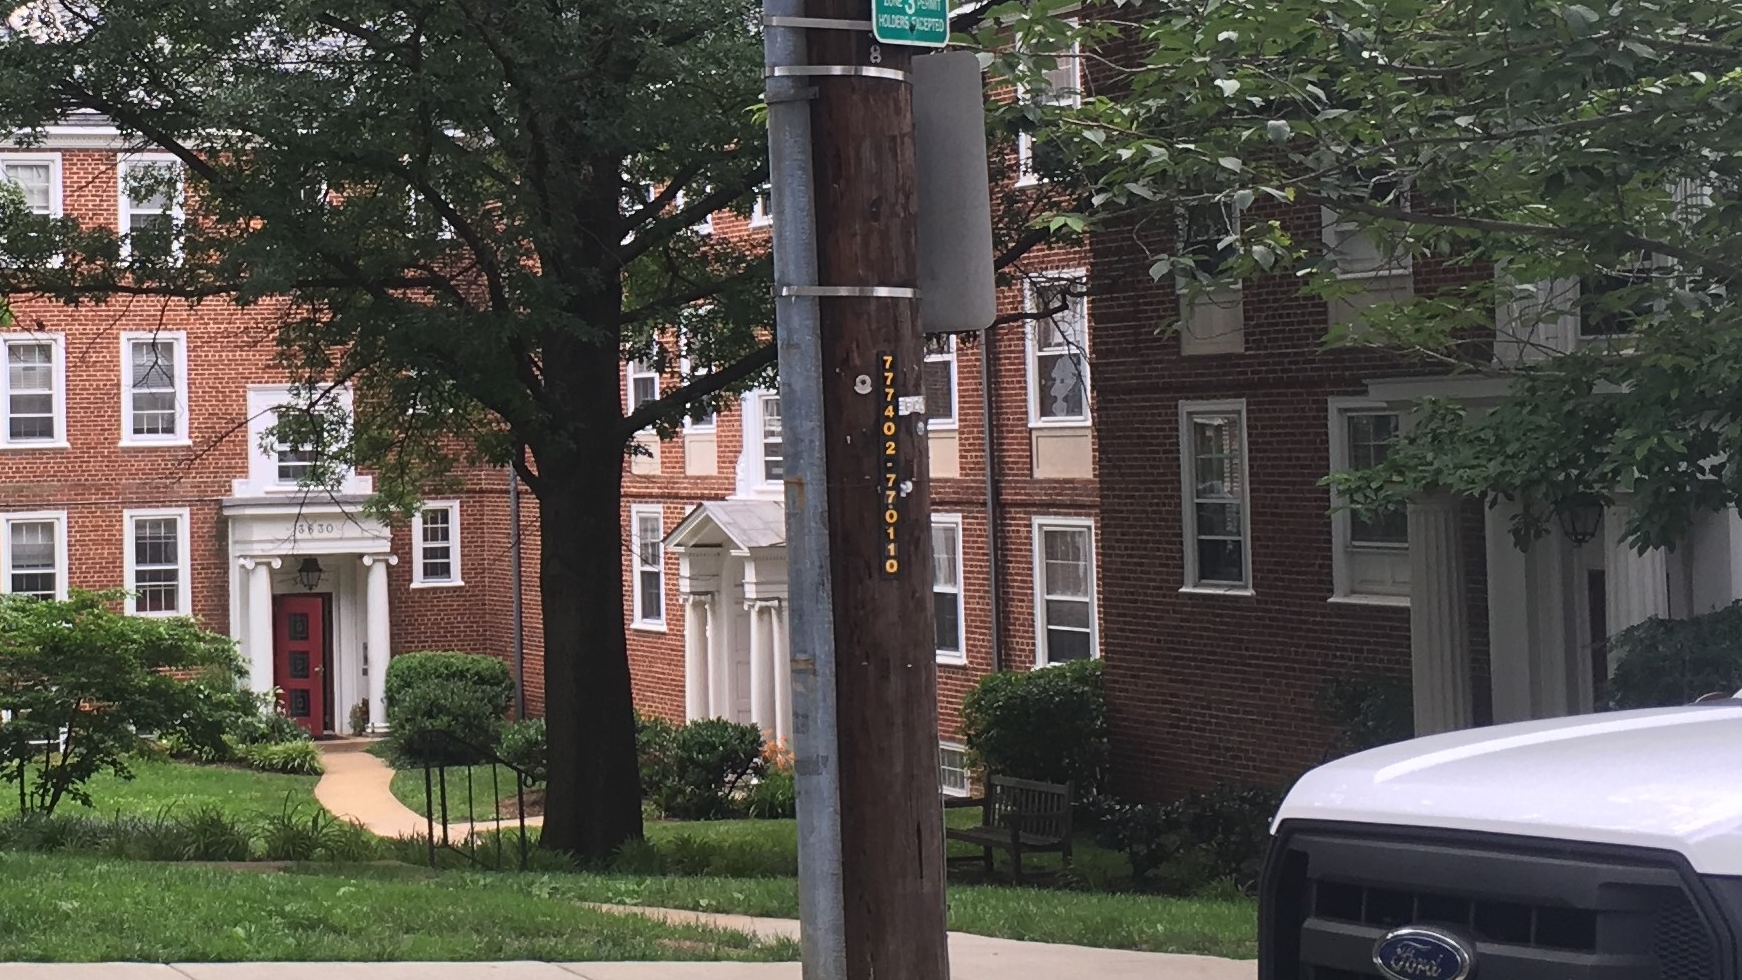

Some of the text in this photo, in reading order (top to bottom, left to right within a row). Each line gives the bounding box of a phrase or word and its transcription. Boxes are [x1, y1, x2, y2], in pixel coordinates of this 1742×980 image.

[878, 14, 909, 30] HOLDERS
[298, 523, 334, 535] 3630
[1390, 940, 1444, 978] Ford
